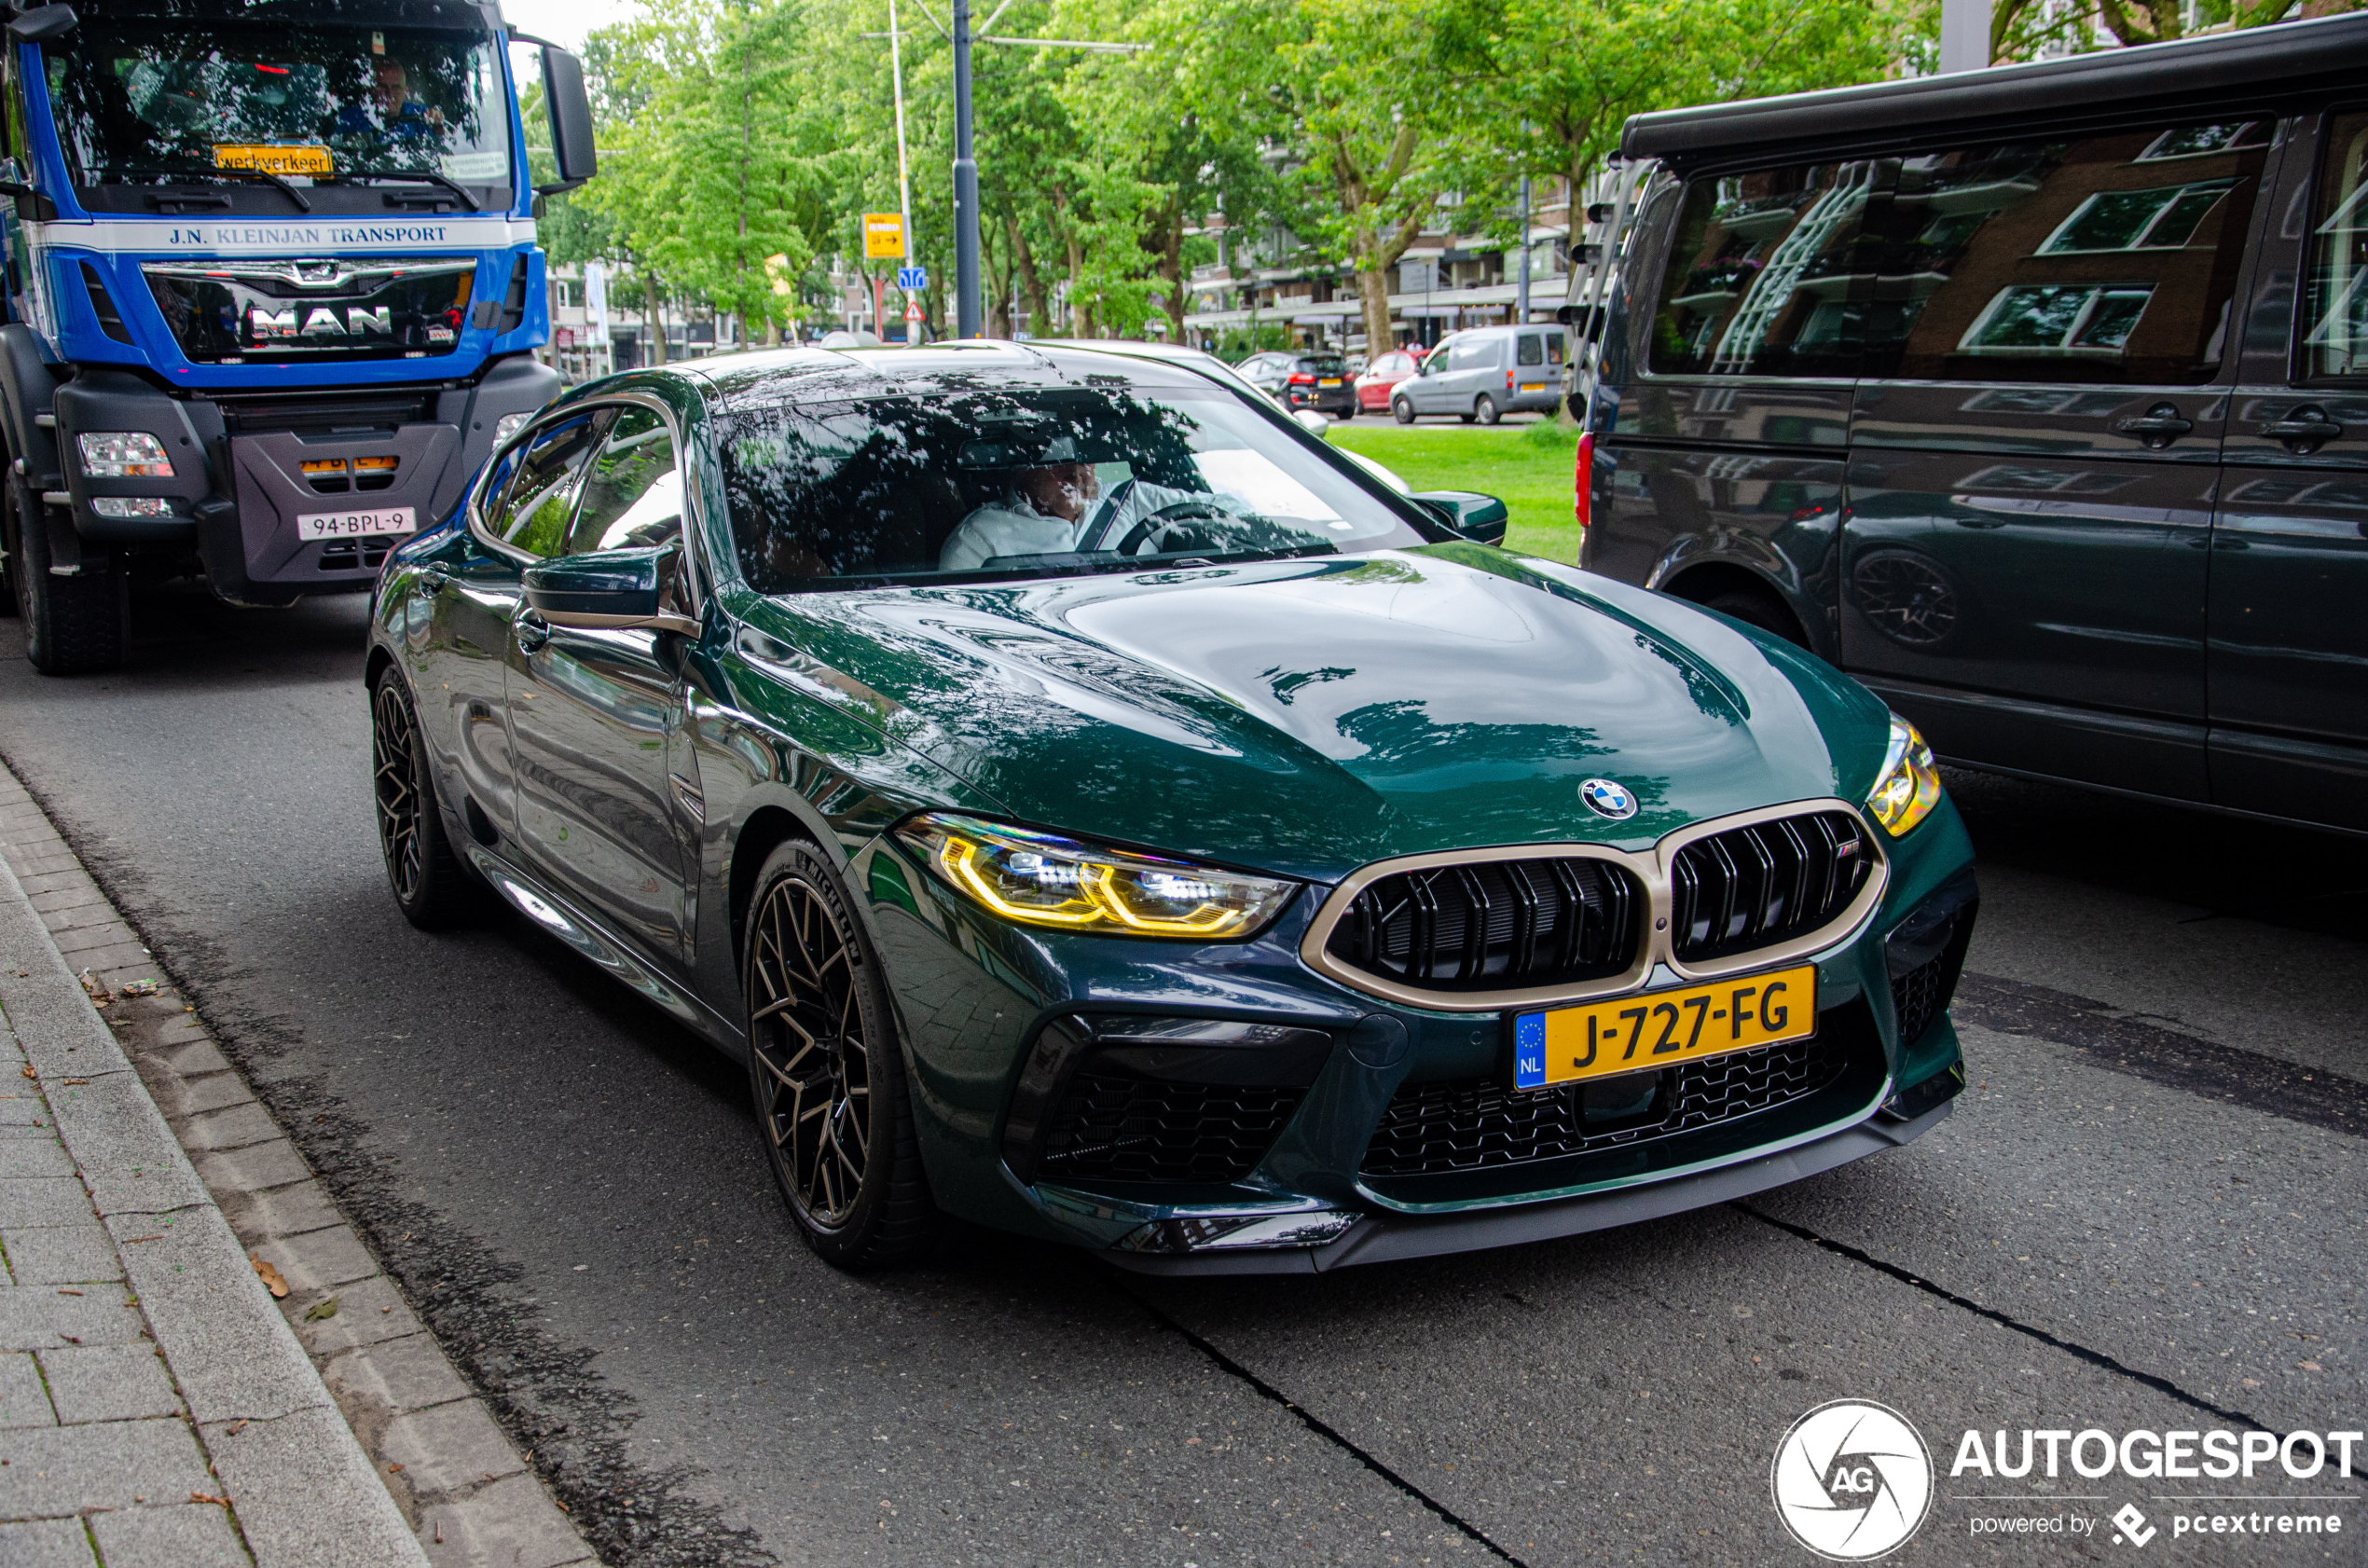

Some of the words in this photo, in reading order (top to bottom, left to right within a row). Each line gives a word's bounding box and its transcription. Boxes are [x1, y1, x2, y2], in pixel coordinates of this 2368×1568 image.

[220, 153, 326, 171] werkverkeer
[459, 166, 495, 176] Rotterdam
[170, 228, 207, 244] J.N.
[216, 227, 320, 244] KLEINJAN
[327, 227, 447, 243] TRANSPORT
[251, 305, 392, 338] MAN
[313, 513, 404, 535] 94-BPL-9
[806, 860, 860, 958] MICHELIN
[1521, 1057, 1542, 1075] NL
[1573, 982, 1788, 1067] J-727-FG
